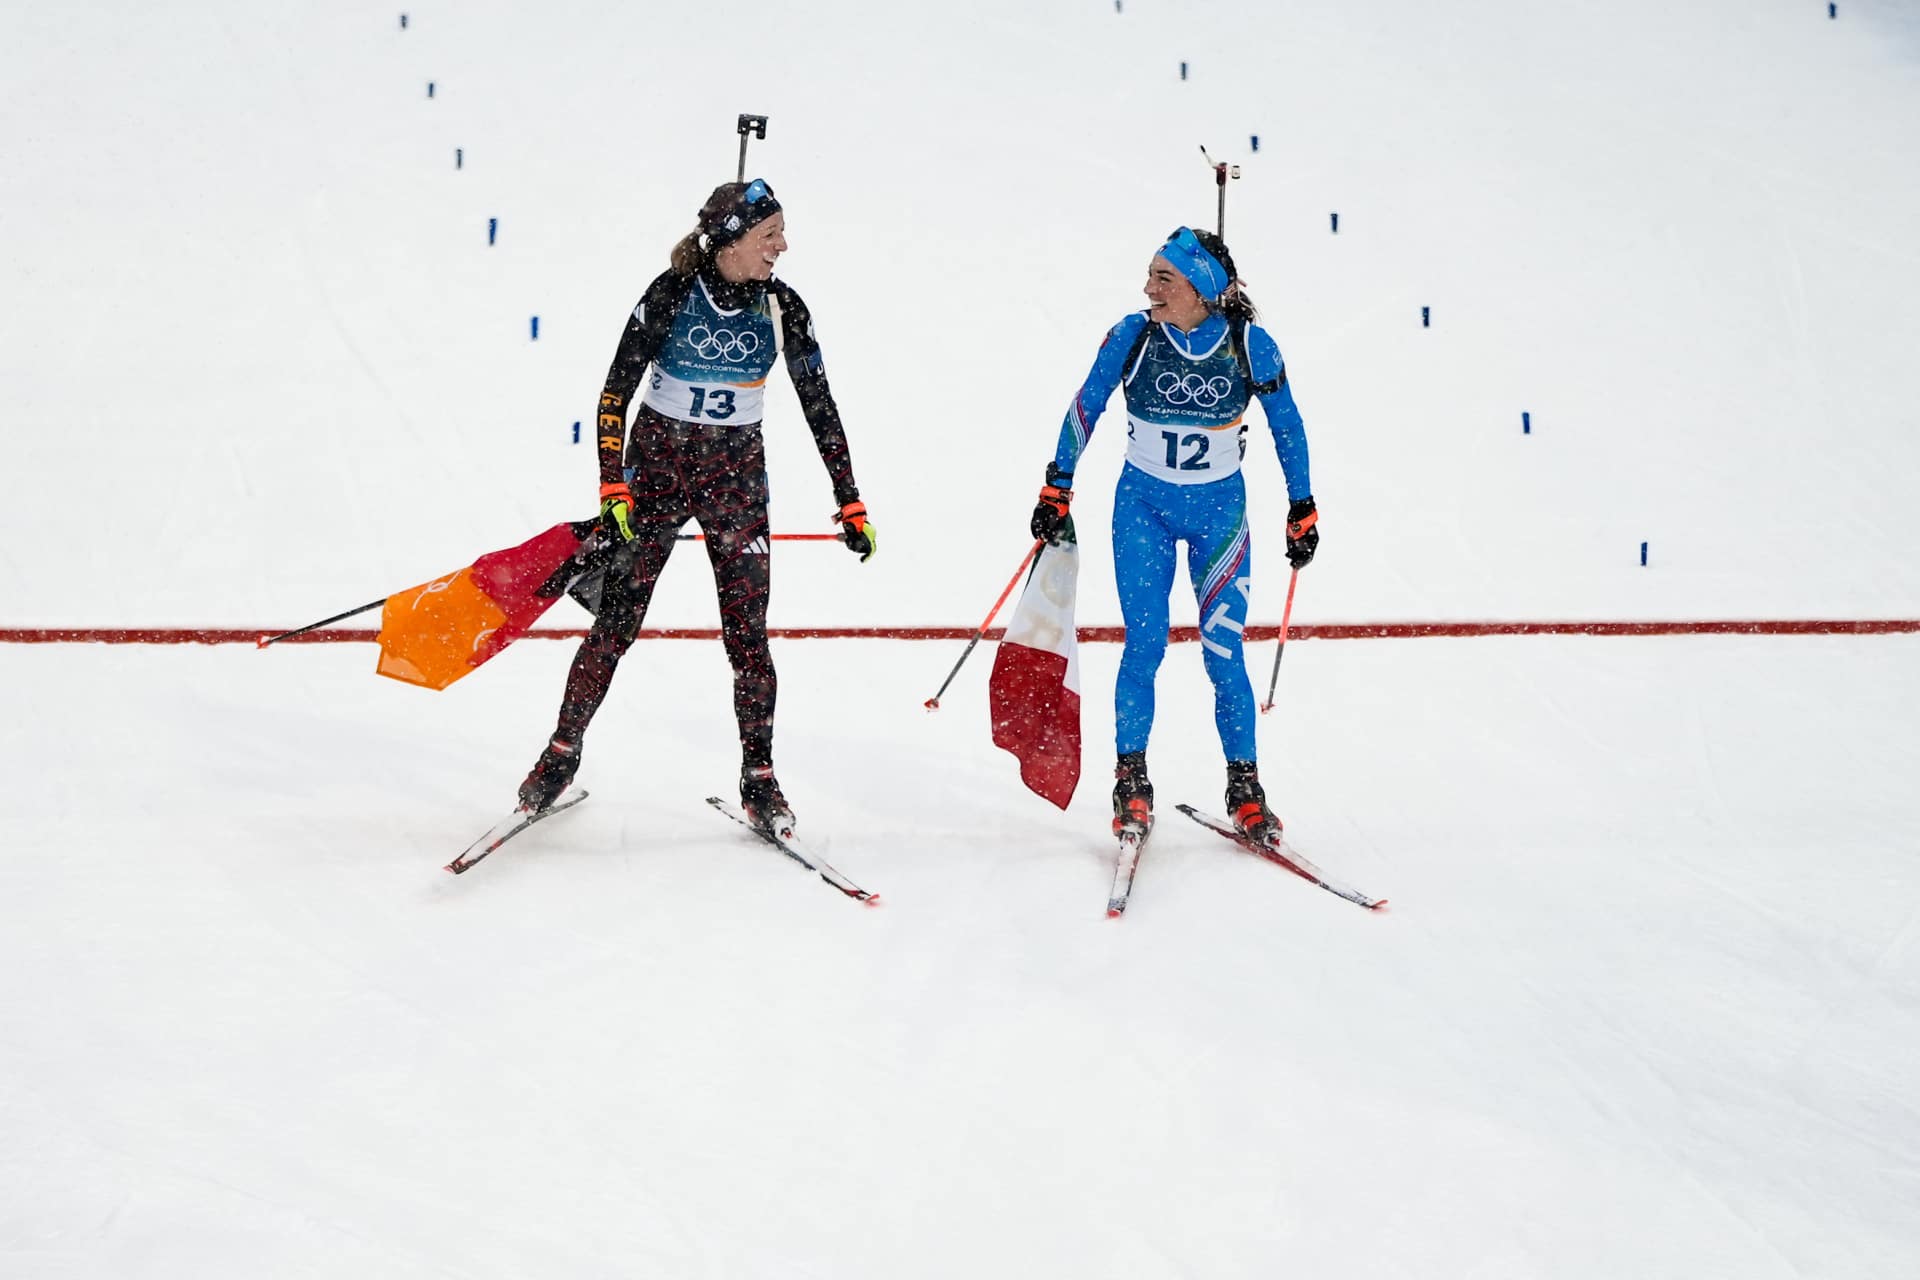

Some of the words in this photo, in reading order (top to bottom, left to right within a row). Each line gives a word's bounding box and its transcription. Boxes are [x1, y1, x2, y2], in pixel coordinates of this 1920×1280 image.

[600, 392, 622, 452] GER
[689, 386, 736, 420] 13
[1161, 430, 1210, 470] 12
